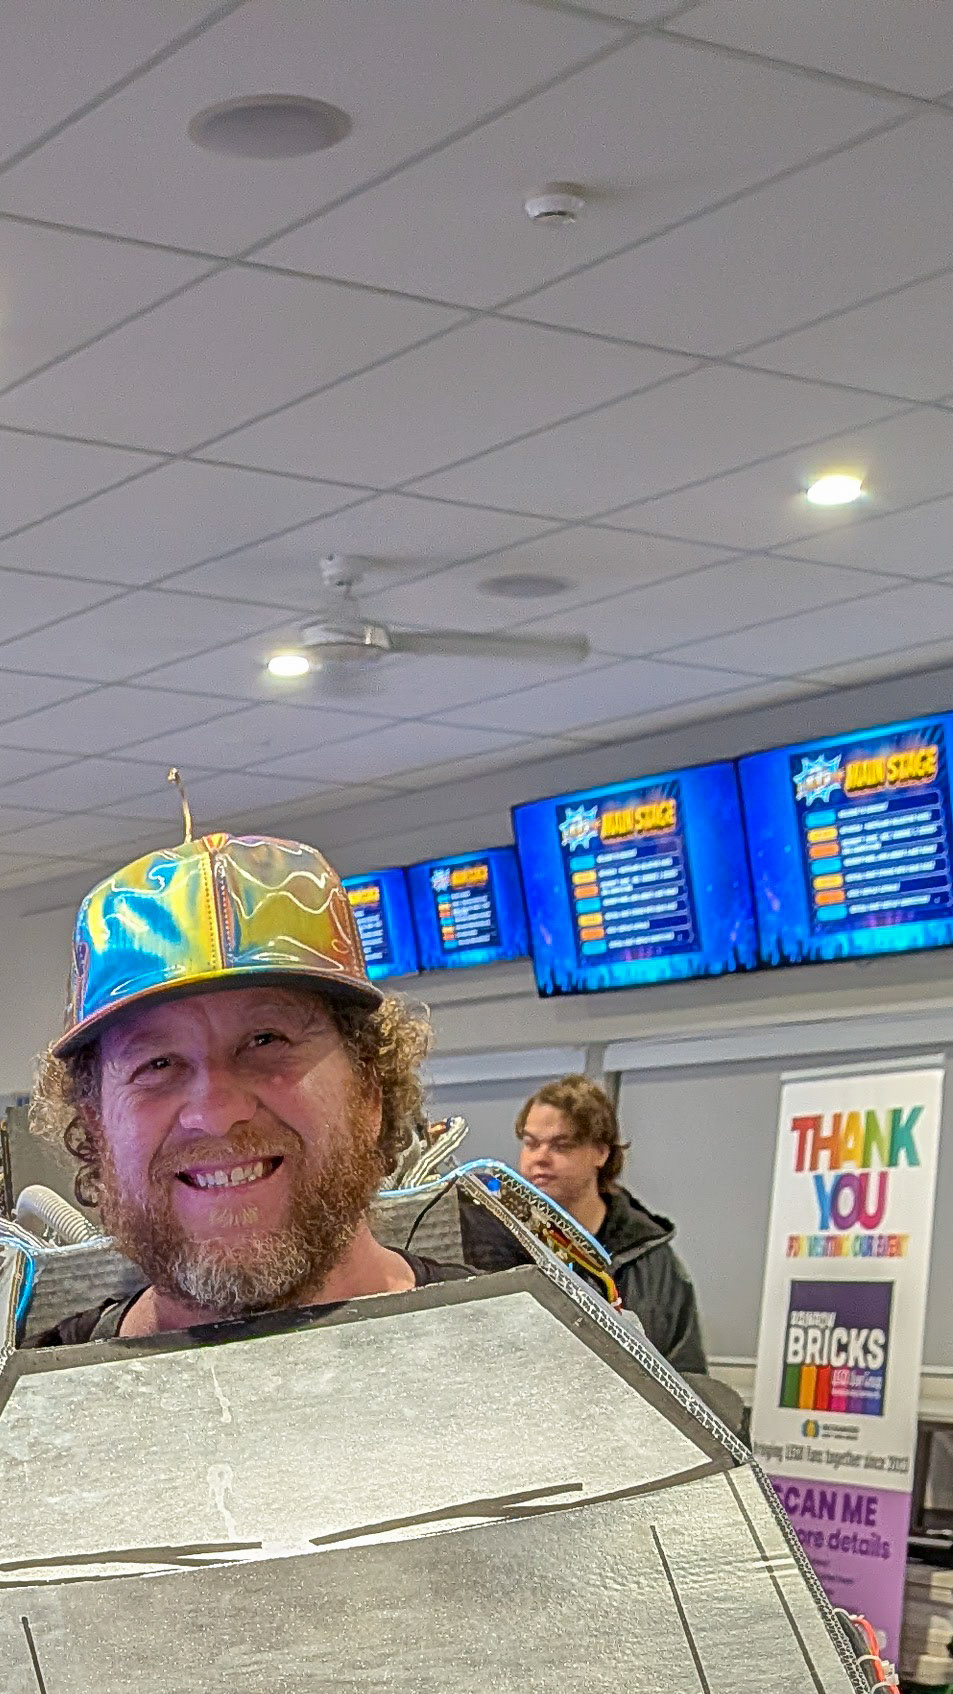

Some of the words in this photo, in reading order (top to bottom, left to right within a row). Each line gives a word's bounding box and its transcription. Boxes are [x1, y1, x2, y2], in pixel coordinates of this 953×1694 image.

[846, 757, 886, 792] MAIN
[887, 746, 938, 785] STAGE
[635, 799, 677, 834] STAGE
[791, 1105, 924, 1173] THANK
[813, 1171, 889, 1231] YOU
[786, 1326, 886, 1371] BRICKS
[826, 1448, 863, 1471] together
[841, 1492, 878, 1527] ME
[828, 1528, 890, 1560] details
